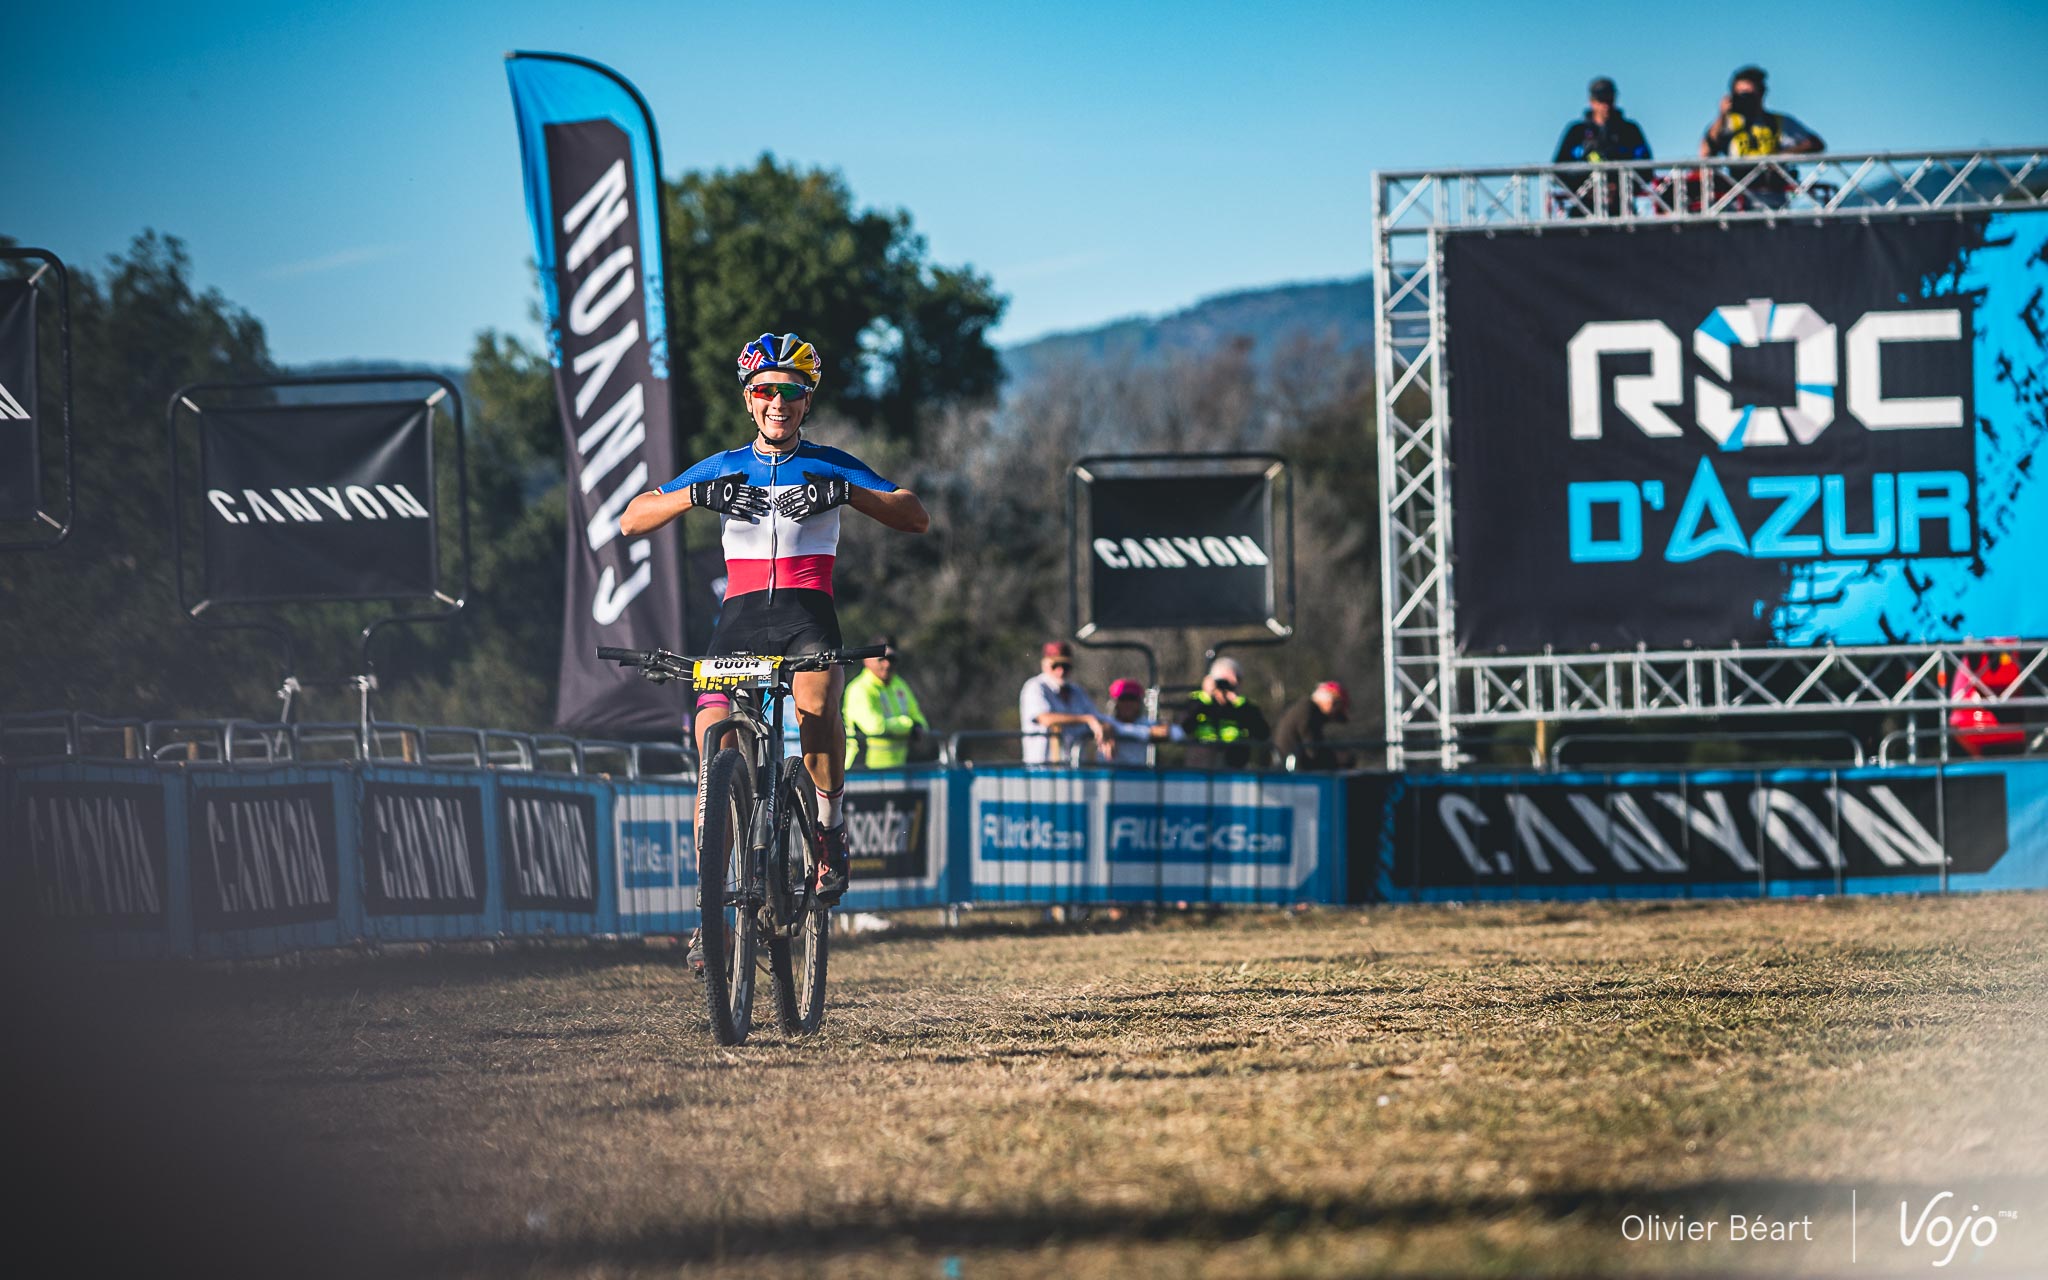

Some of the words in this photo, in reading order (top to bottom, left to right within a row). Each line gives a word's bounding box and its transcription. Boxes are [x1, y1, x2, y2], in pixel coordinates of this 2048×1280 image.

[562, 158, 652, 625] CANYON
[1568, 298, 1964, 452] ROC
[207, 483, 430, 525] CANYON
[1093, 535, 1269, 569] CANYON
[1568, 455, 1973, 564] D'AZUR
[1438, 786, 1946, 874] CANYON
